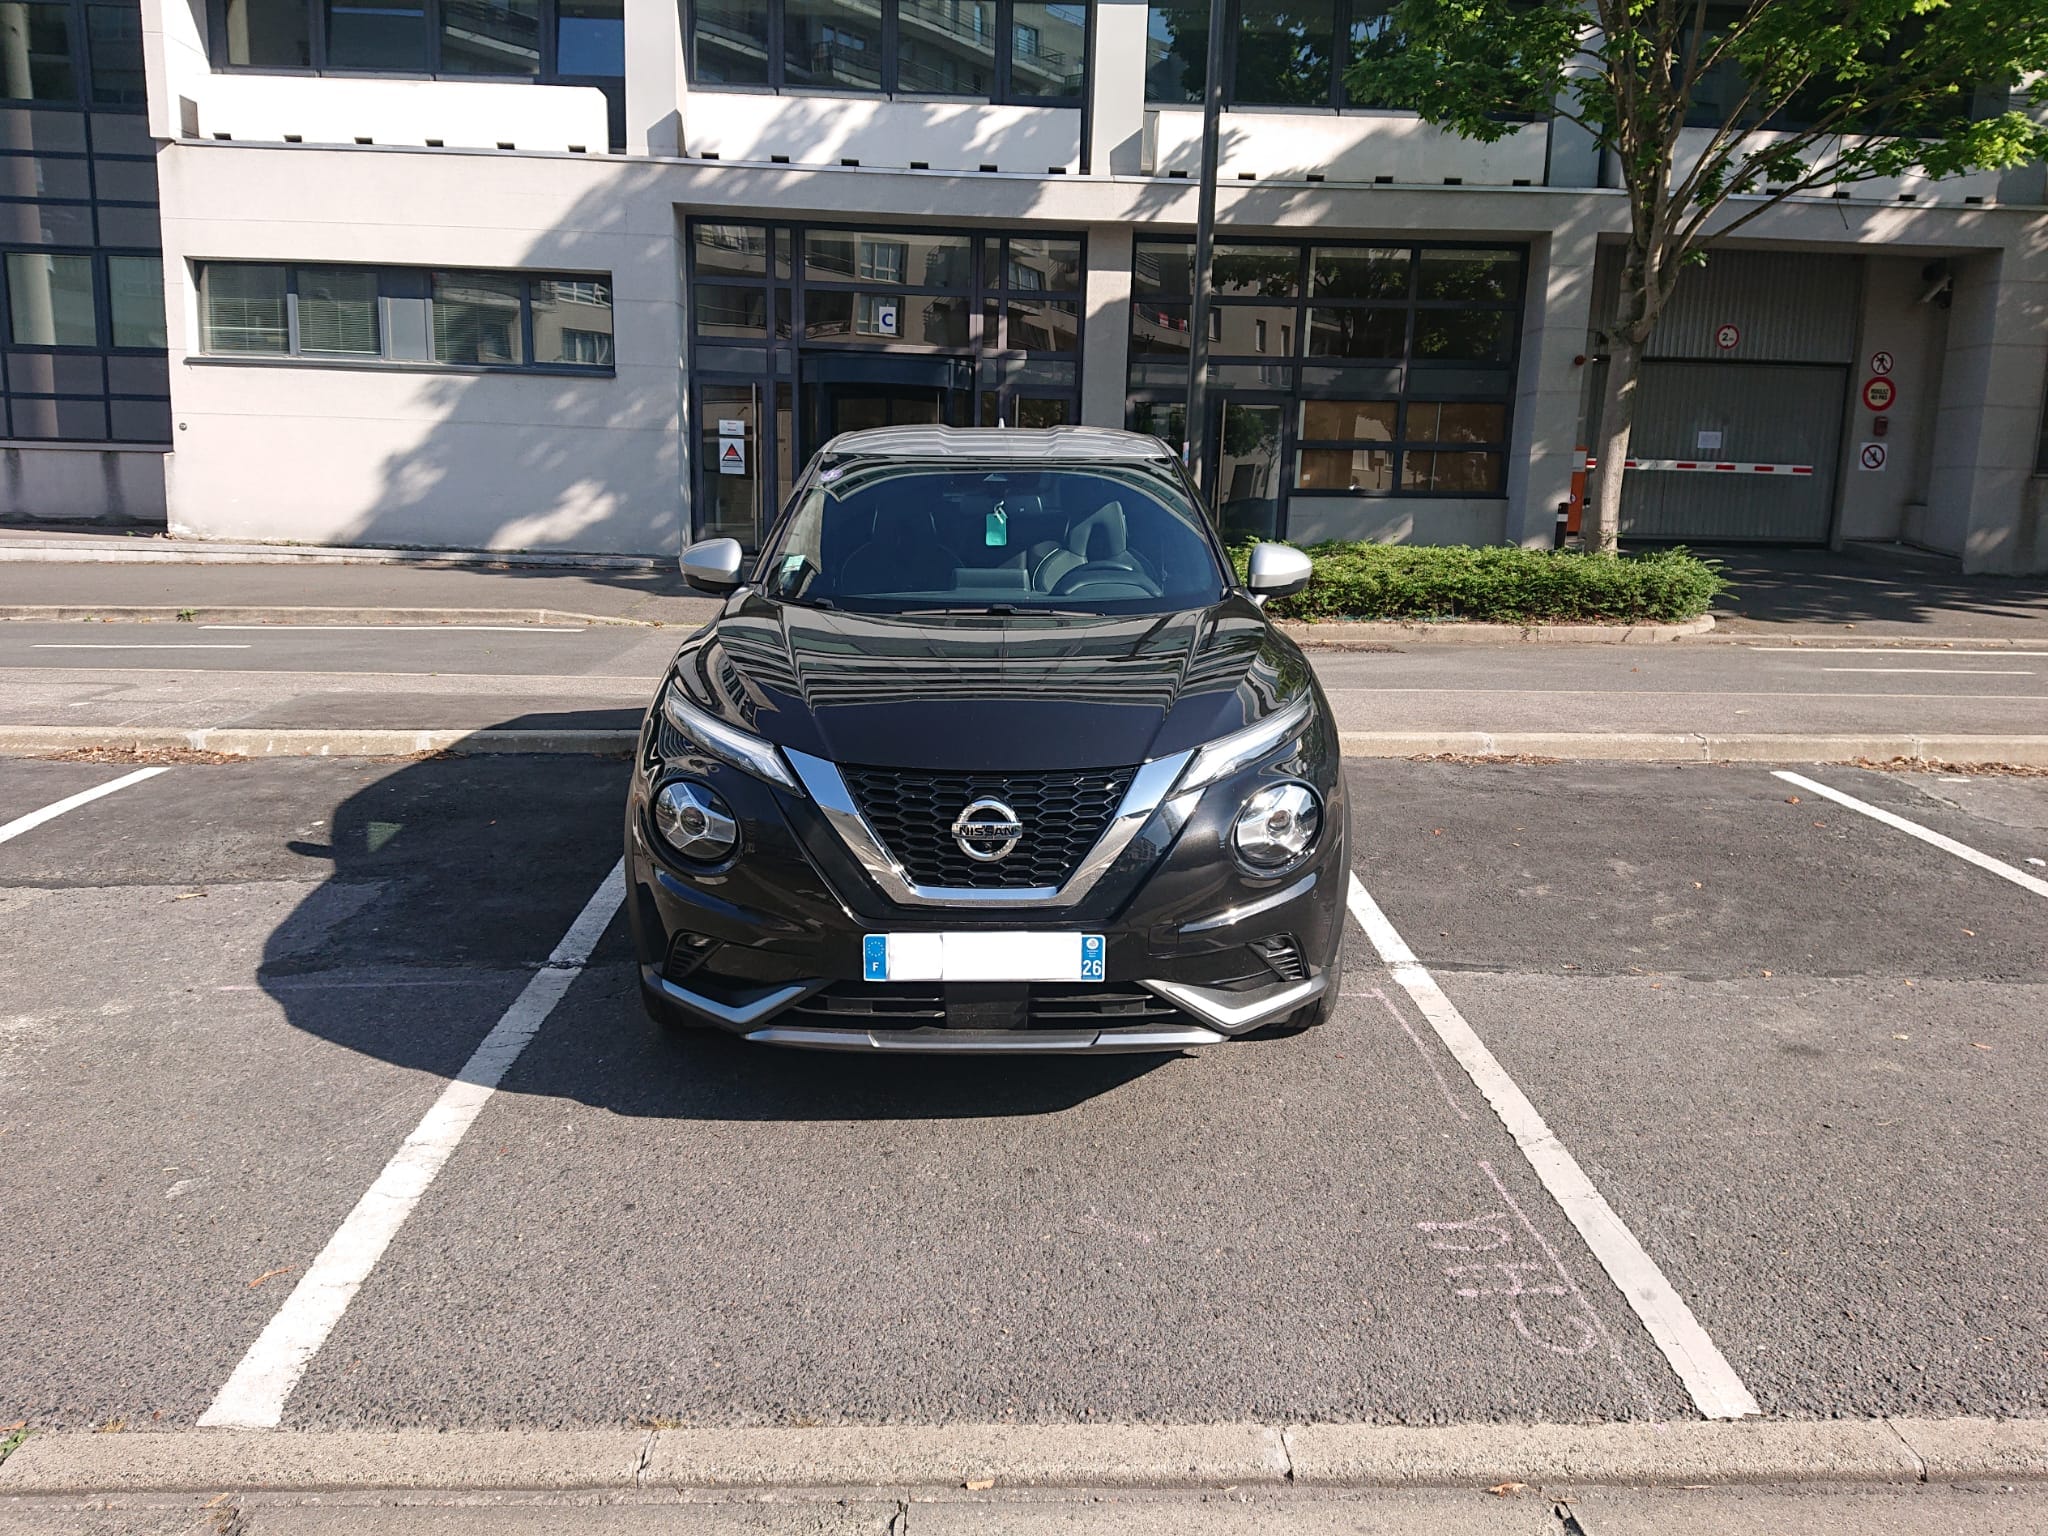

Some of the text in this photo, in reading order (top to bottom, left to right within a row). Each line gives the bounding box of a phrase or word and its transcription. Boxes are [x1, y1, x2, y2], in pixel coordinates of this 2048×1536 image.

[882, 313, 893, 327] C
[959, 825, 1014, 836] NISSAN
[872, 962, 879, 972] F
[1082, 959, 1102, 976] 26
